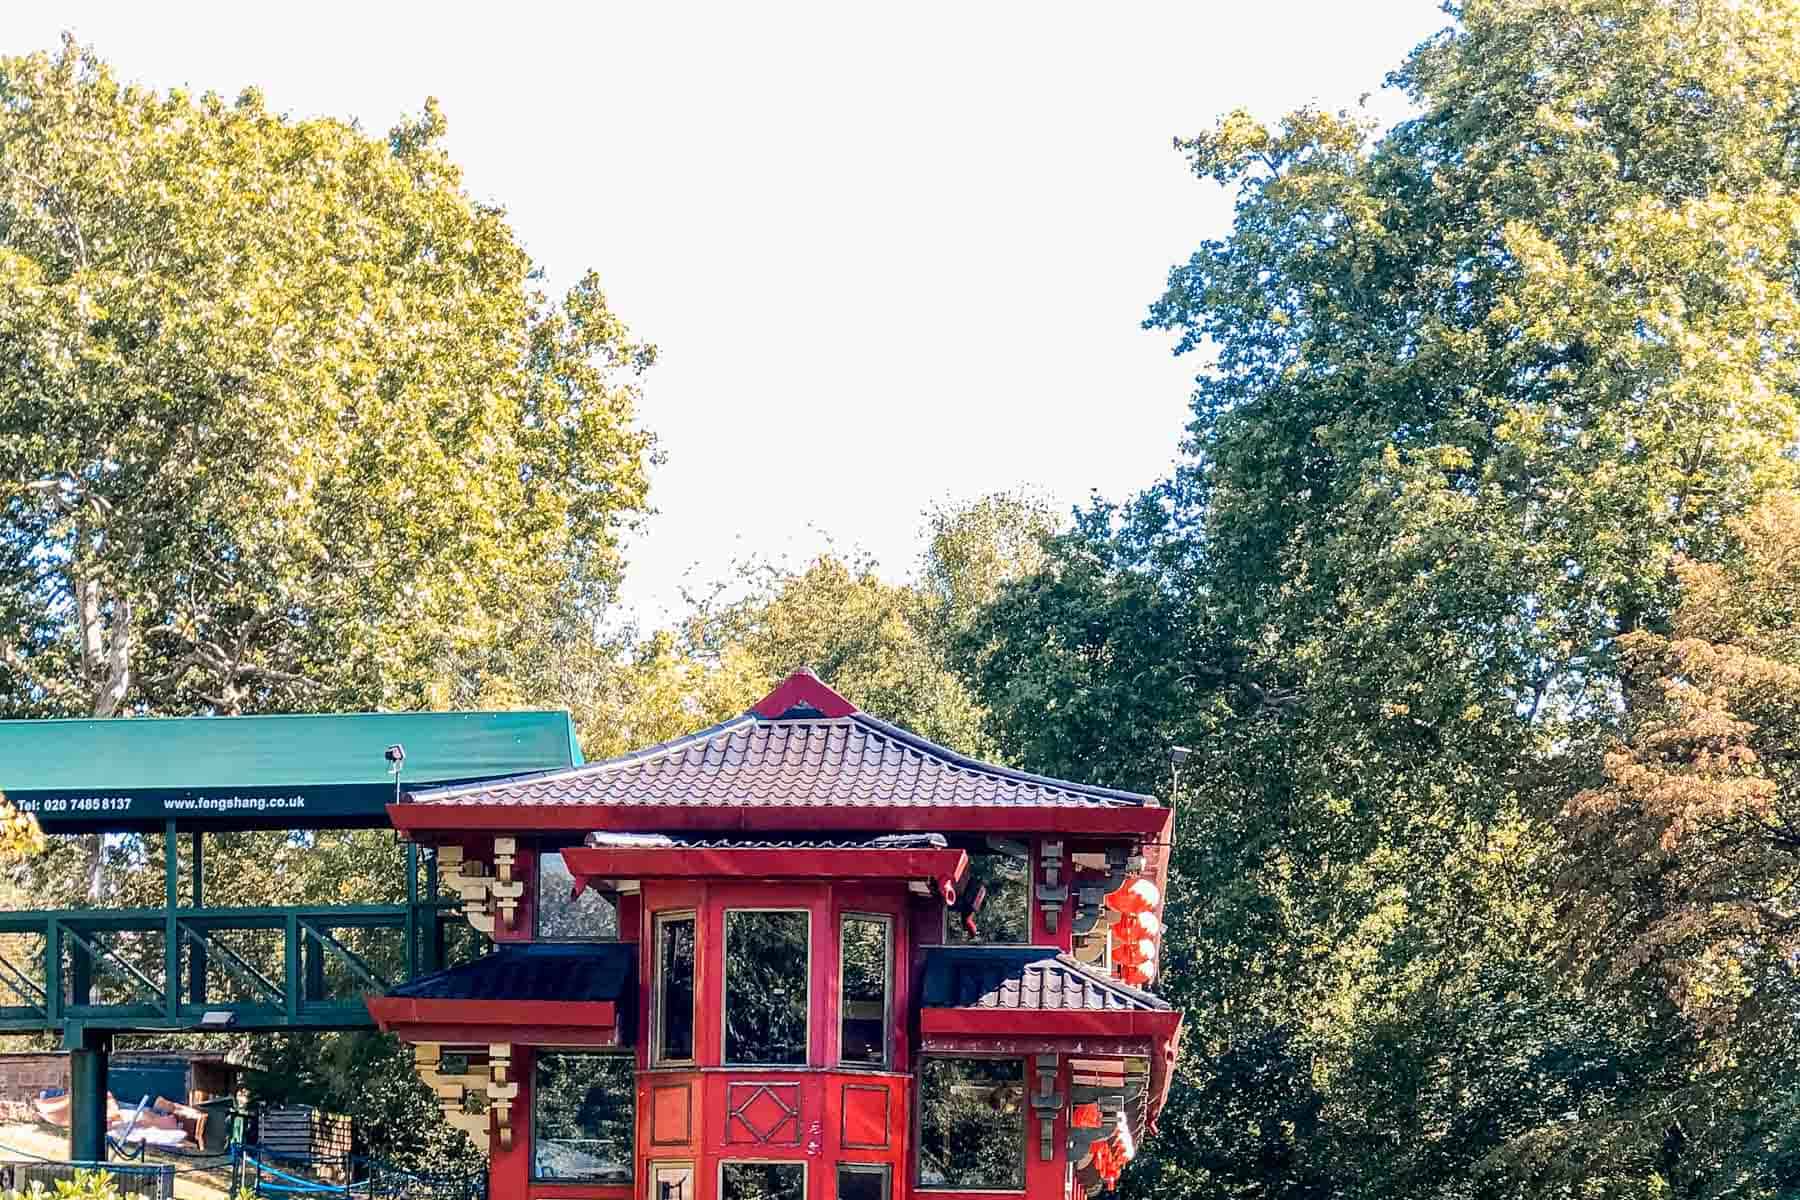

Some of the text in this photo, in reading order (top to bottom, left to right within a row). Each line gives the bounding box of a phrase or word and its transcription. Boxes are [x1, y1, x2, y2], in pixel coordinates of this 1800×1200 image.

[17, 799, 40, 811] Tel:
[44, 799, 67, 811] 020
[164, 795, 305, 811] www.fengshang.co.uk
